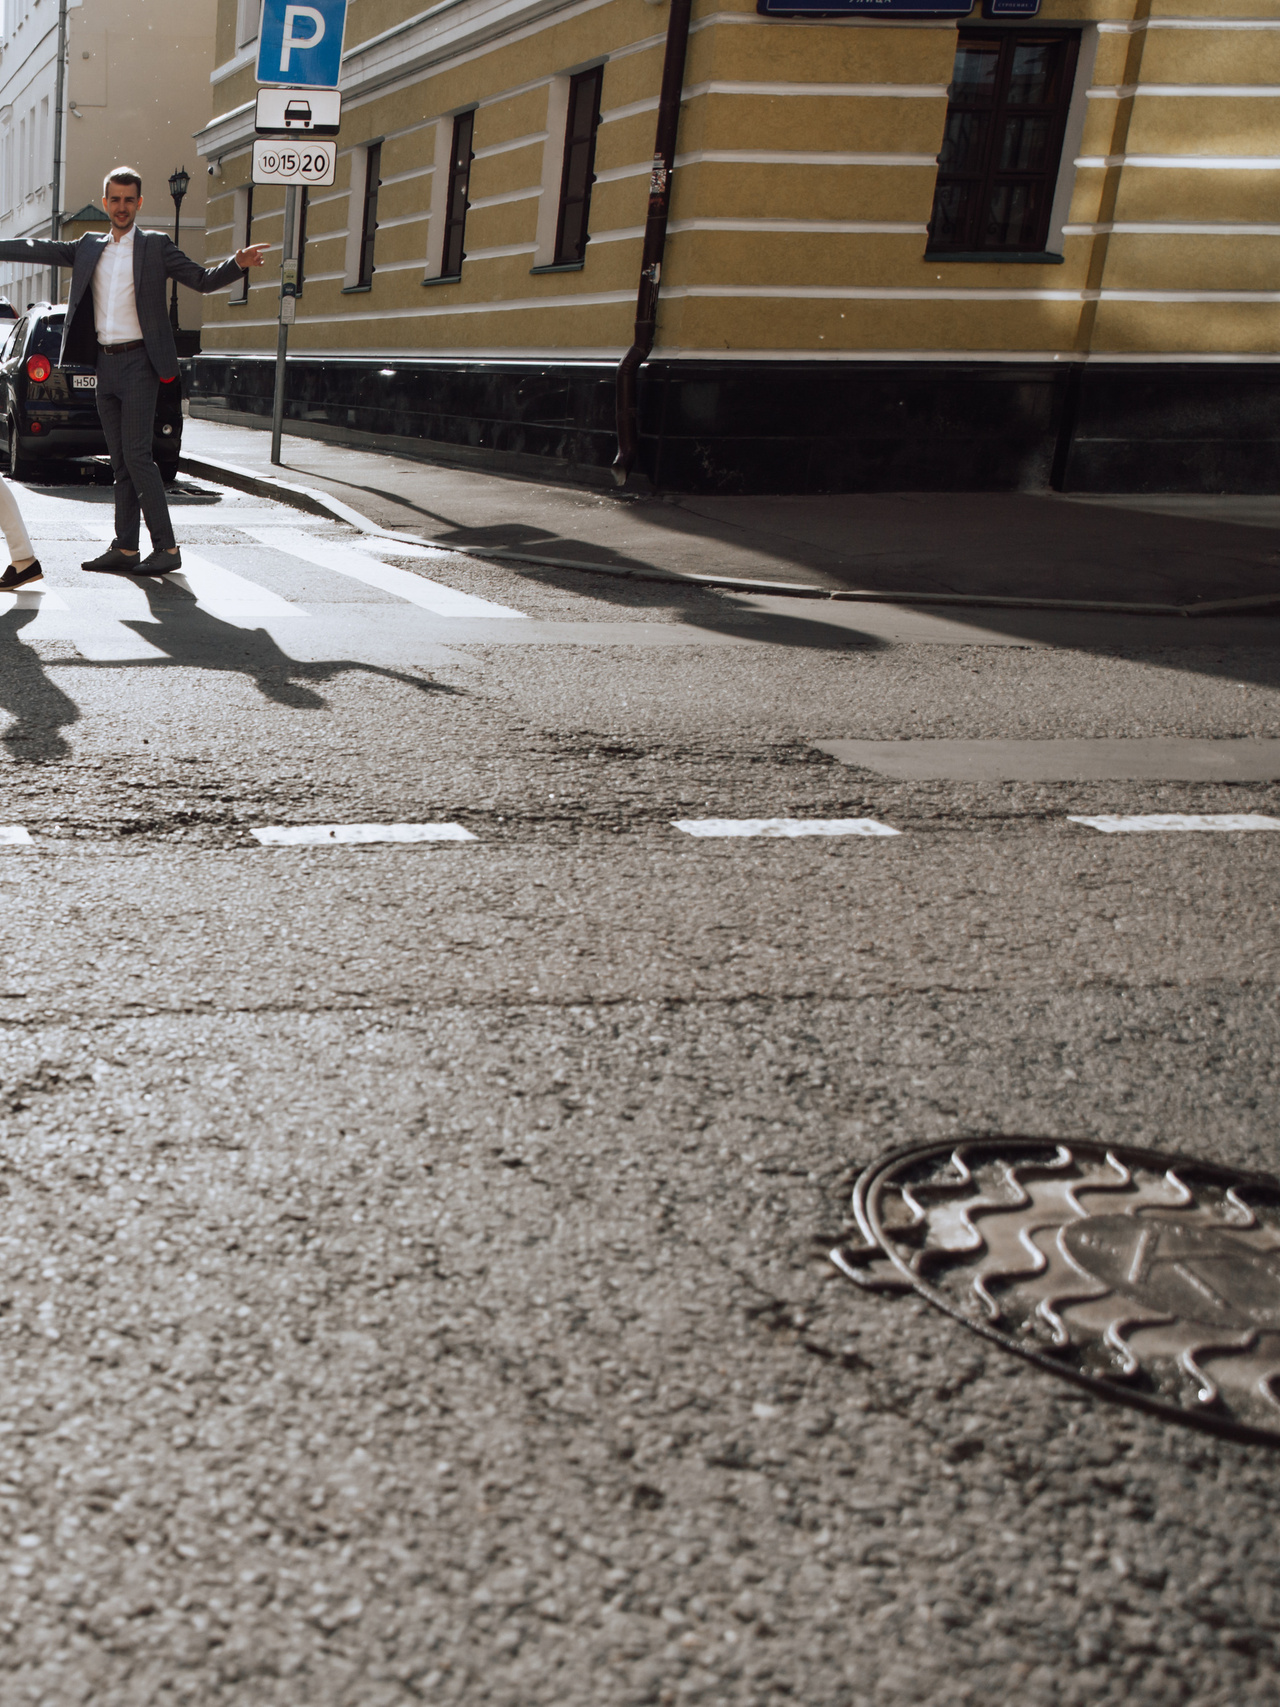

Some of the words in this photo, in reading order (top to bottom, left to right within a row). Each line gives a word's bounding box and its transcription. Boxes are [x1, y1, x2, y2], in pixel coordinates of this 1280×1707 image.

[279, 5, 326, 72] P
[262, 155, 276, 168] 10
[280, 154, 296, 170] 15
[301, 154, 326, 173] 20
